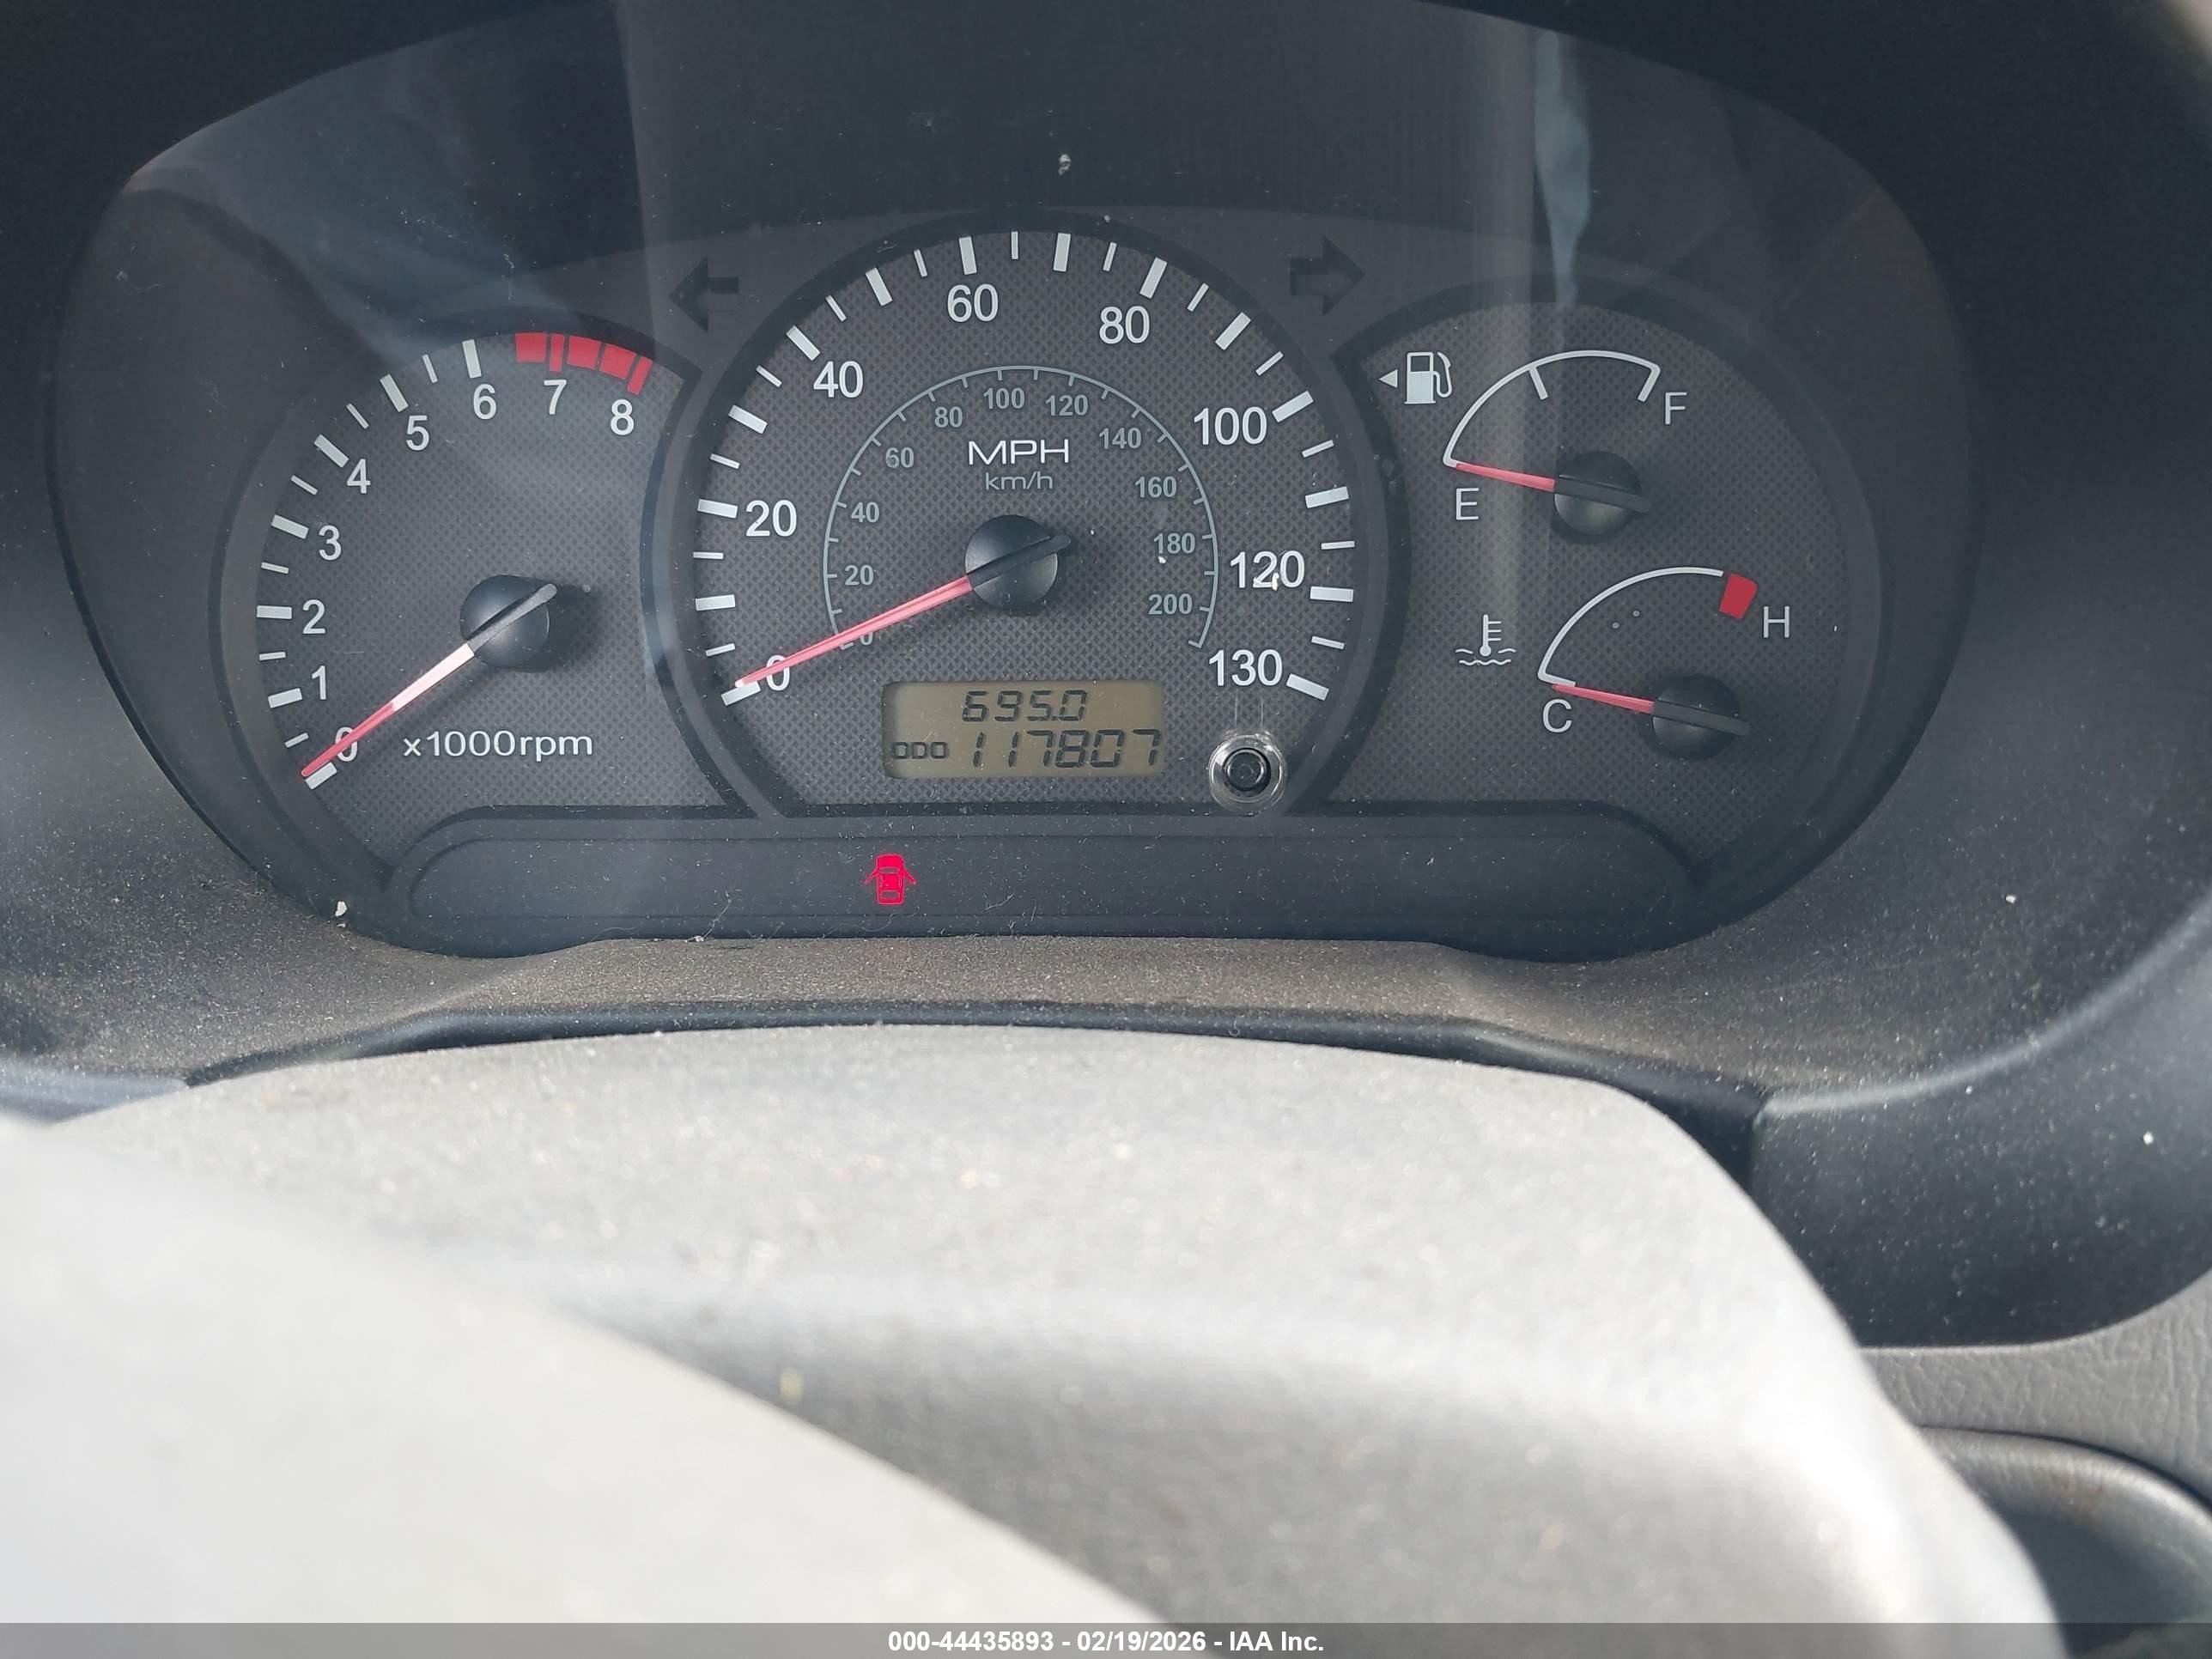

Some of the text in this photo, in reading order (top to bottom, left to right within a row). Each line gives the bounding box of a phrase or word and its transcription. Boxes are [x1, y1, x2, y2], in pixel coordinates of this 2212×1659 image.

[946, 284, 999, 322] 60
[1099, 306, 1150, 344] 80
[544, 379, 567, 415] 7
[813, 361, 864, 398] 40
[472, 384, 497, 420] 6
[983, 387, 1025, 410] 100
[1045, 395, 1089, 417] 120
[1665, 392, 1687, 425] F
[406, 415, 430, 451] 5
[610, 399, 635, 435] 8
[934, 408, 963, 428] 80
[1194, 408, 1267, 446] 100
[968, 440, 1070, 465] MPH
[1099, 428, 1142, 450] 140
[885, 447, 915, 469] 60
[346, 459, 371, 494] 4
[985, 471, 1054, 491] km/h
[1135, 476, 1177, 498] 160
[746, 500, 797, 538] 20
[851, 502, 879, 523] 40
[1455, 488, 1480, 520] E
[319, 525, 343, 561] 3
[1153, 533, 1196, 555] 180
[844, 565, 875, 586] 20
[1230, 550, 1305, 589] 120
[302, 599, 326, 635] 2
[1147, 593, 1193, 615] 200
[1763, 606, 1790, 638] H
[311, 665, 327, 700] 1
[766, 654, 791, 692] 0
[1209, 649, 1282, 687] 130
[1543, 699, 1572, 732] C
[334, 727, 359, 762] 0
[403, 731, 593, 762] x1000rpm
[891, 729, 1160, 768] ODO 117807
